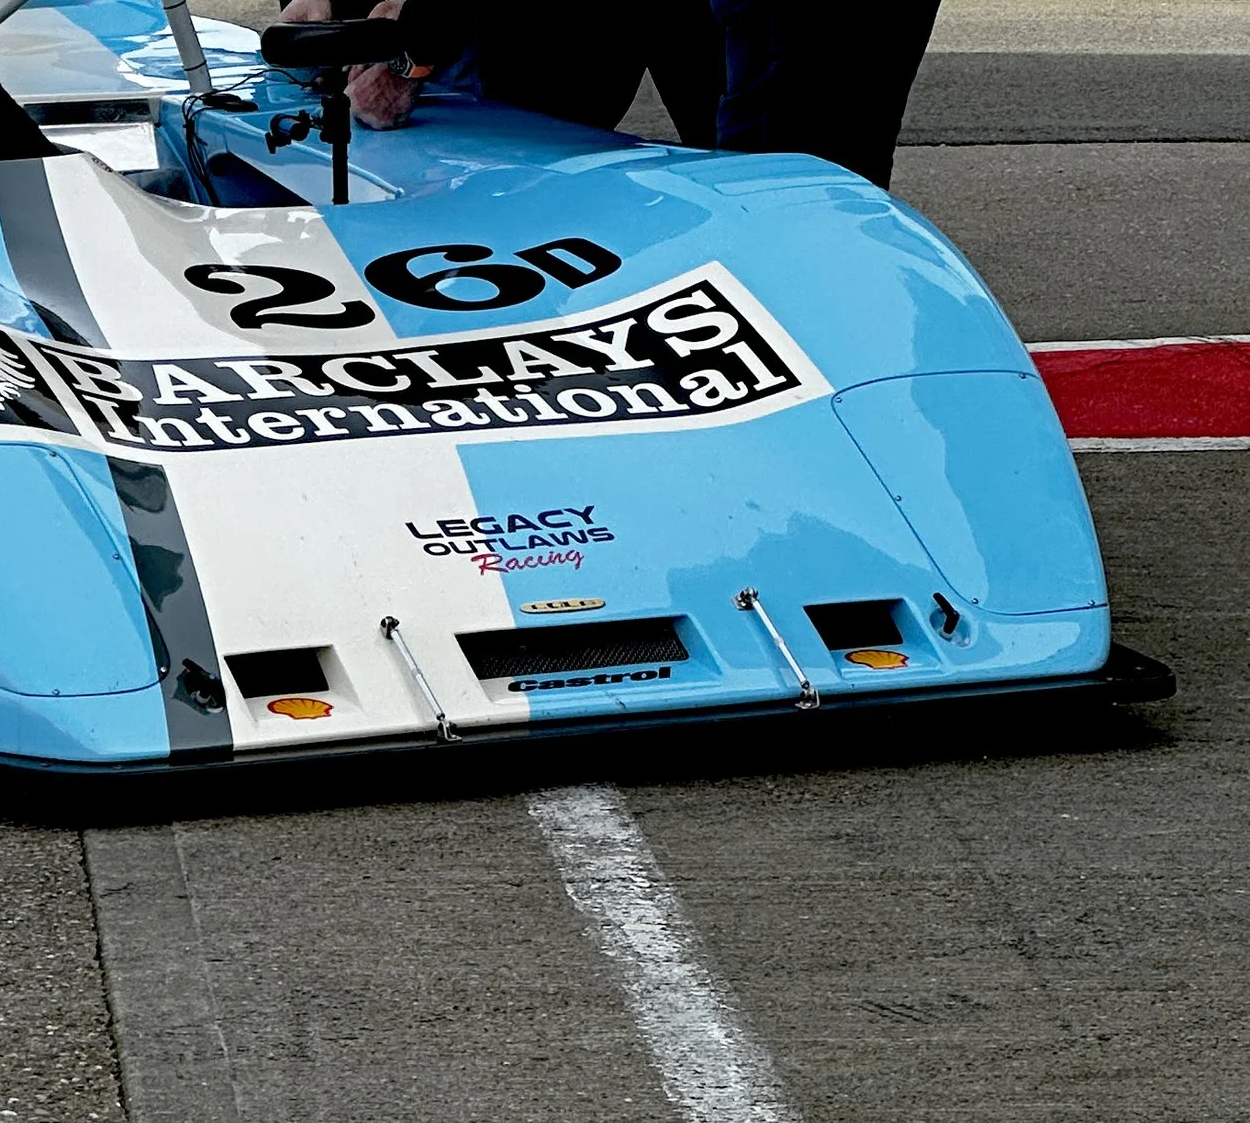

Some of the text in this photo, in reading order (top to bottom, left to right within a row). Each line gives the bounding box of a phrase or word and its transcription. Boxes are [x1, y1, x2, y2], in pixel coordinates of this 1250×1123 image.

[67, 290, 741, 406] BARCLAYS
[91, 343, 783, 449] International
[405, 505, 595, 539] LEGACY
[423, 527, 615, 556] OUTLAWS
[470, 549, 584, 575] Racing
[508, 667, 671, 692] Castrol
